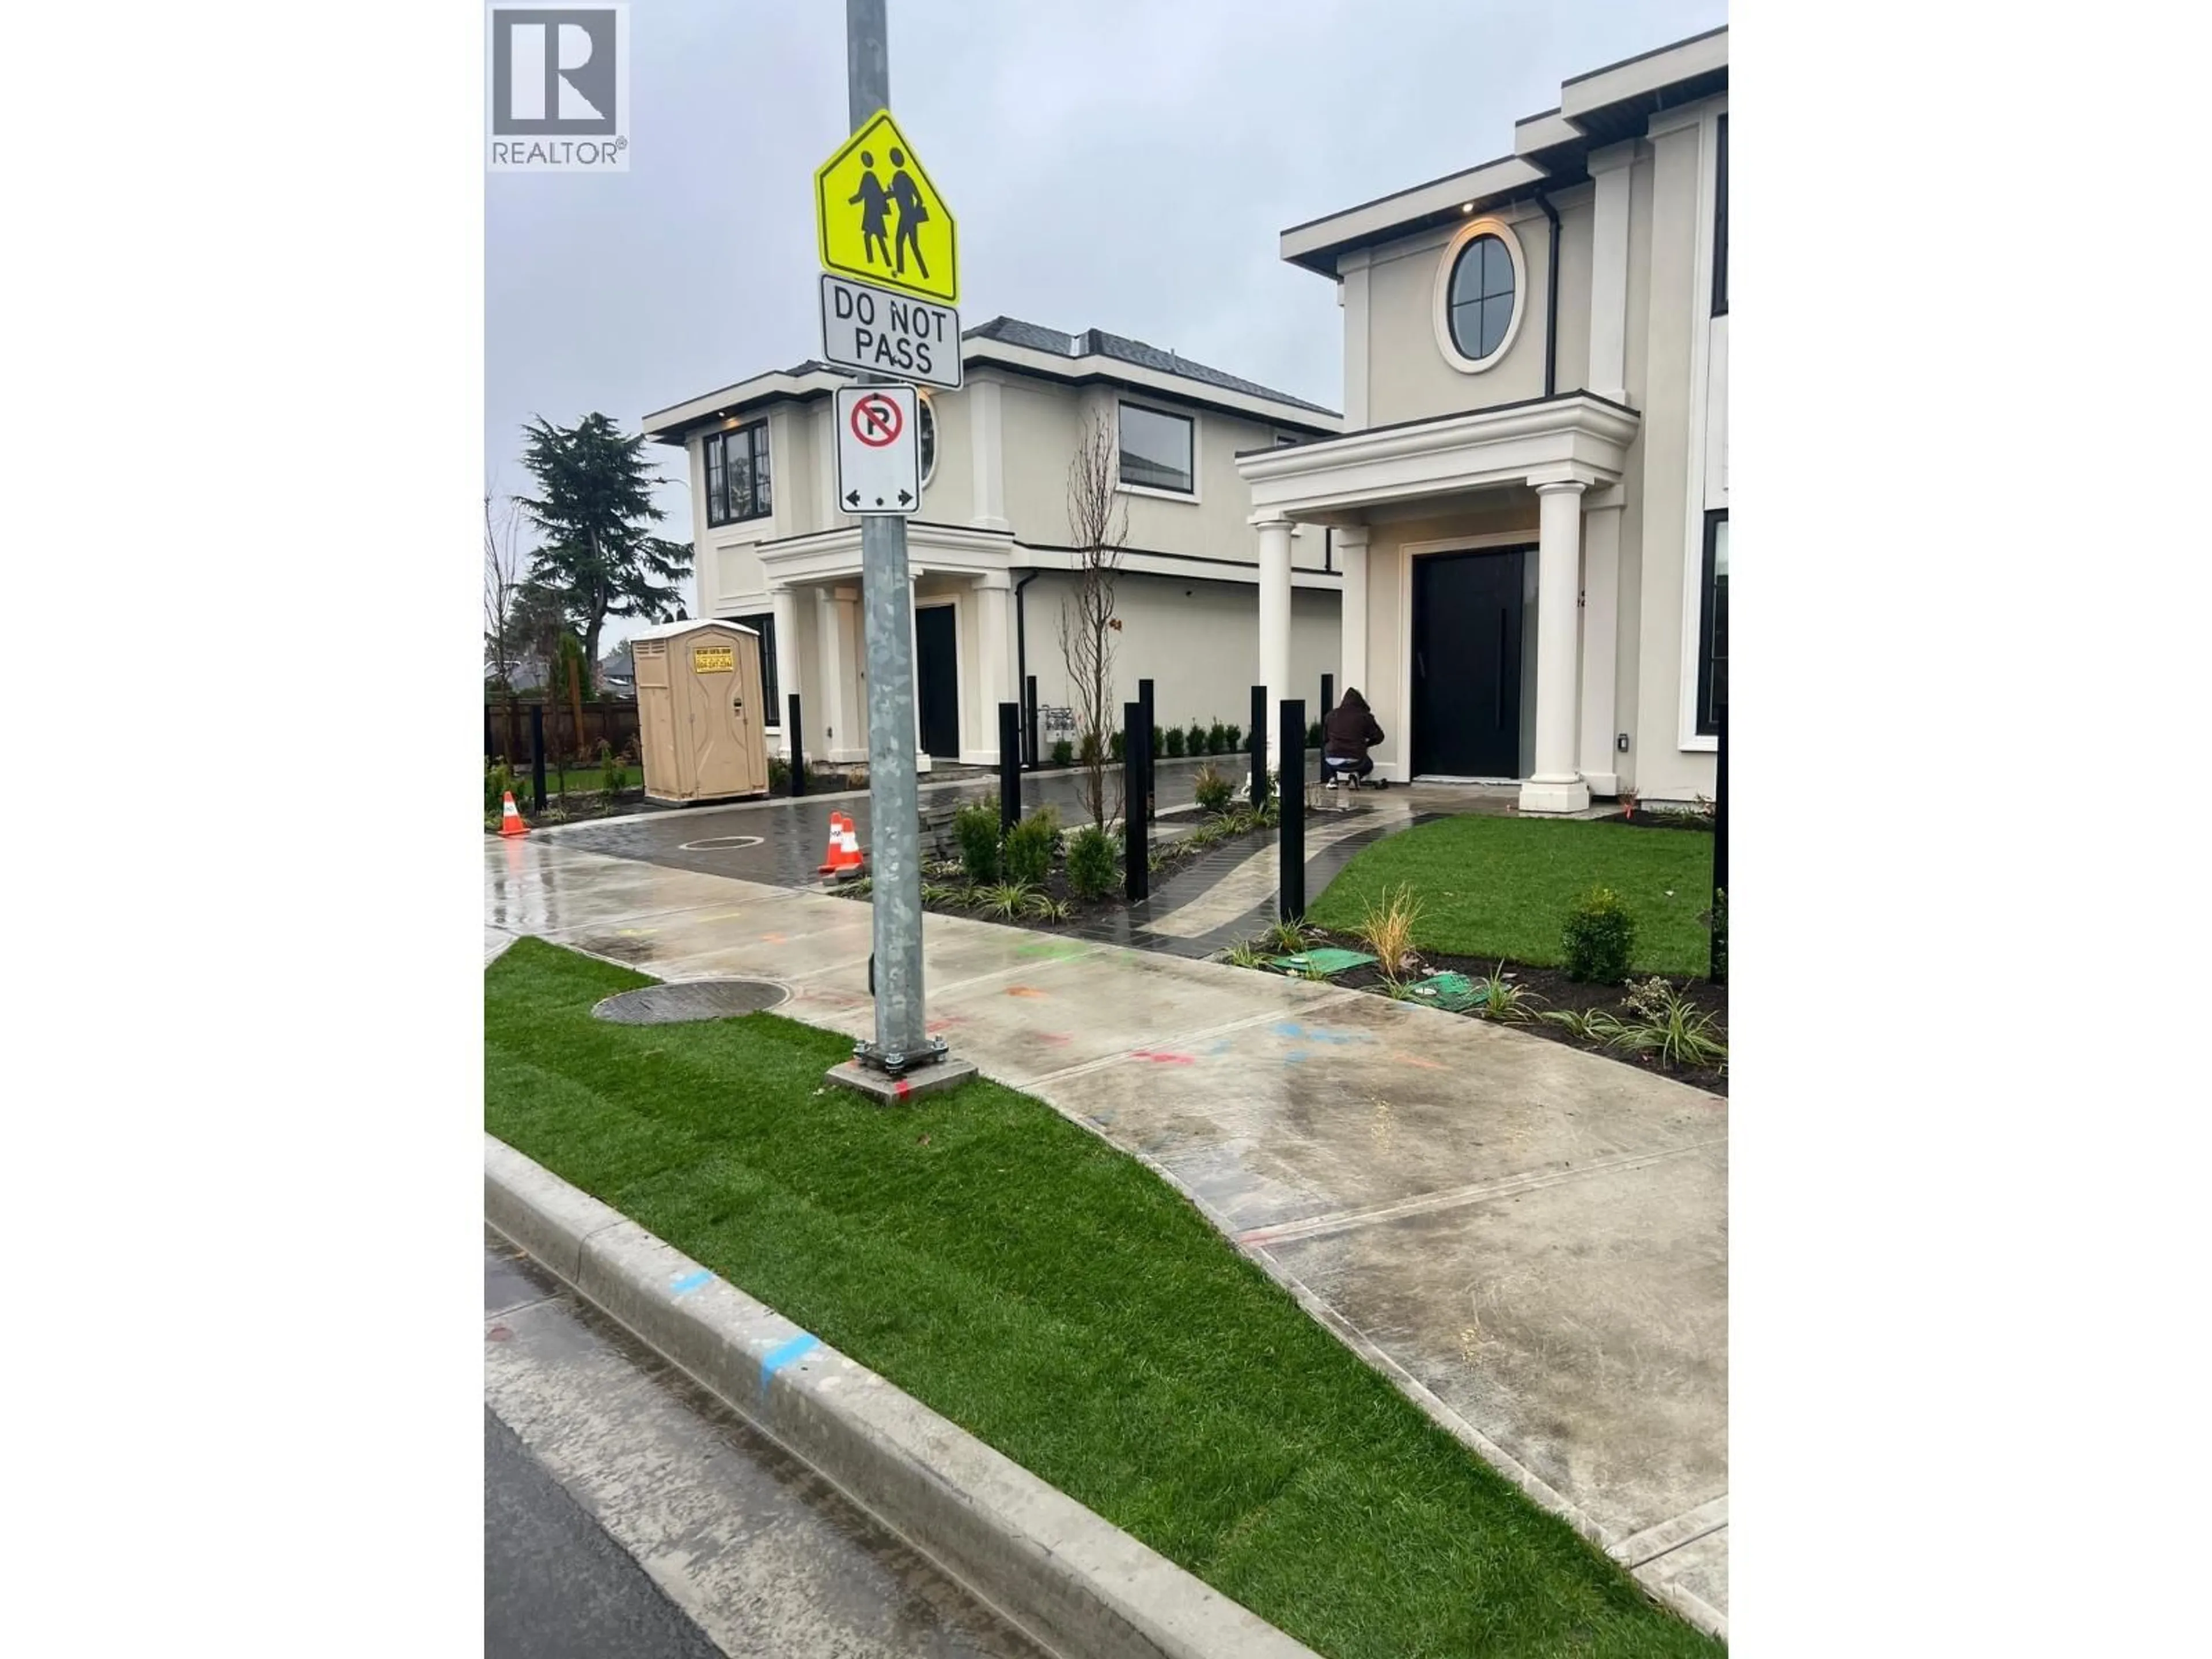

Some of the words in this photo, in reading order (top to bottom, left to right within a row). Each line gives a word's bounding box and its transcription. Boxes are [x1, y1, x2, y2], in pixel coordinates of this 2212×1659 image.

[835, 286, 875, 326] DO
[891, 301, 946, 343] NOT
[855, 327, 933, 375] PASS
[868, 407, 890, 435] P
